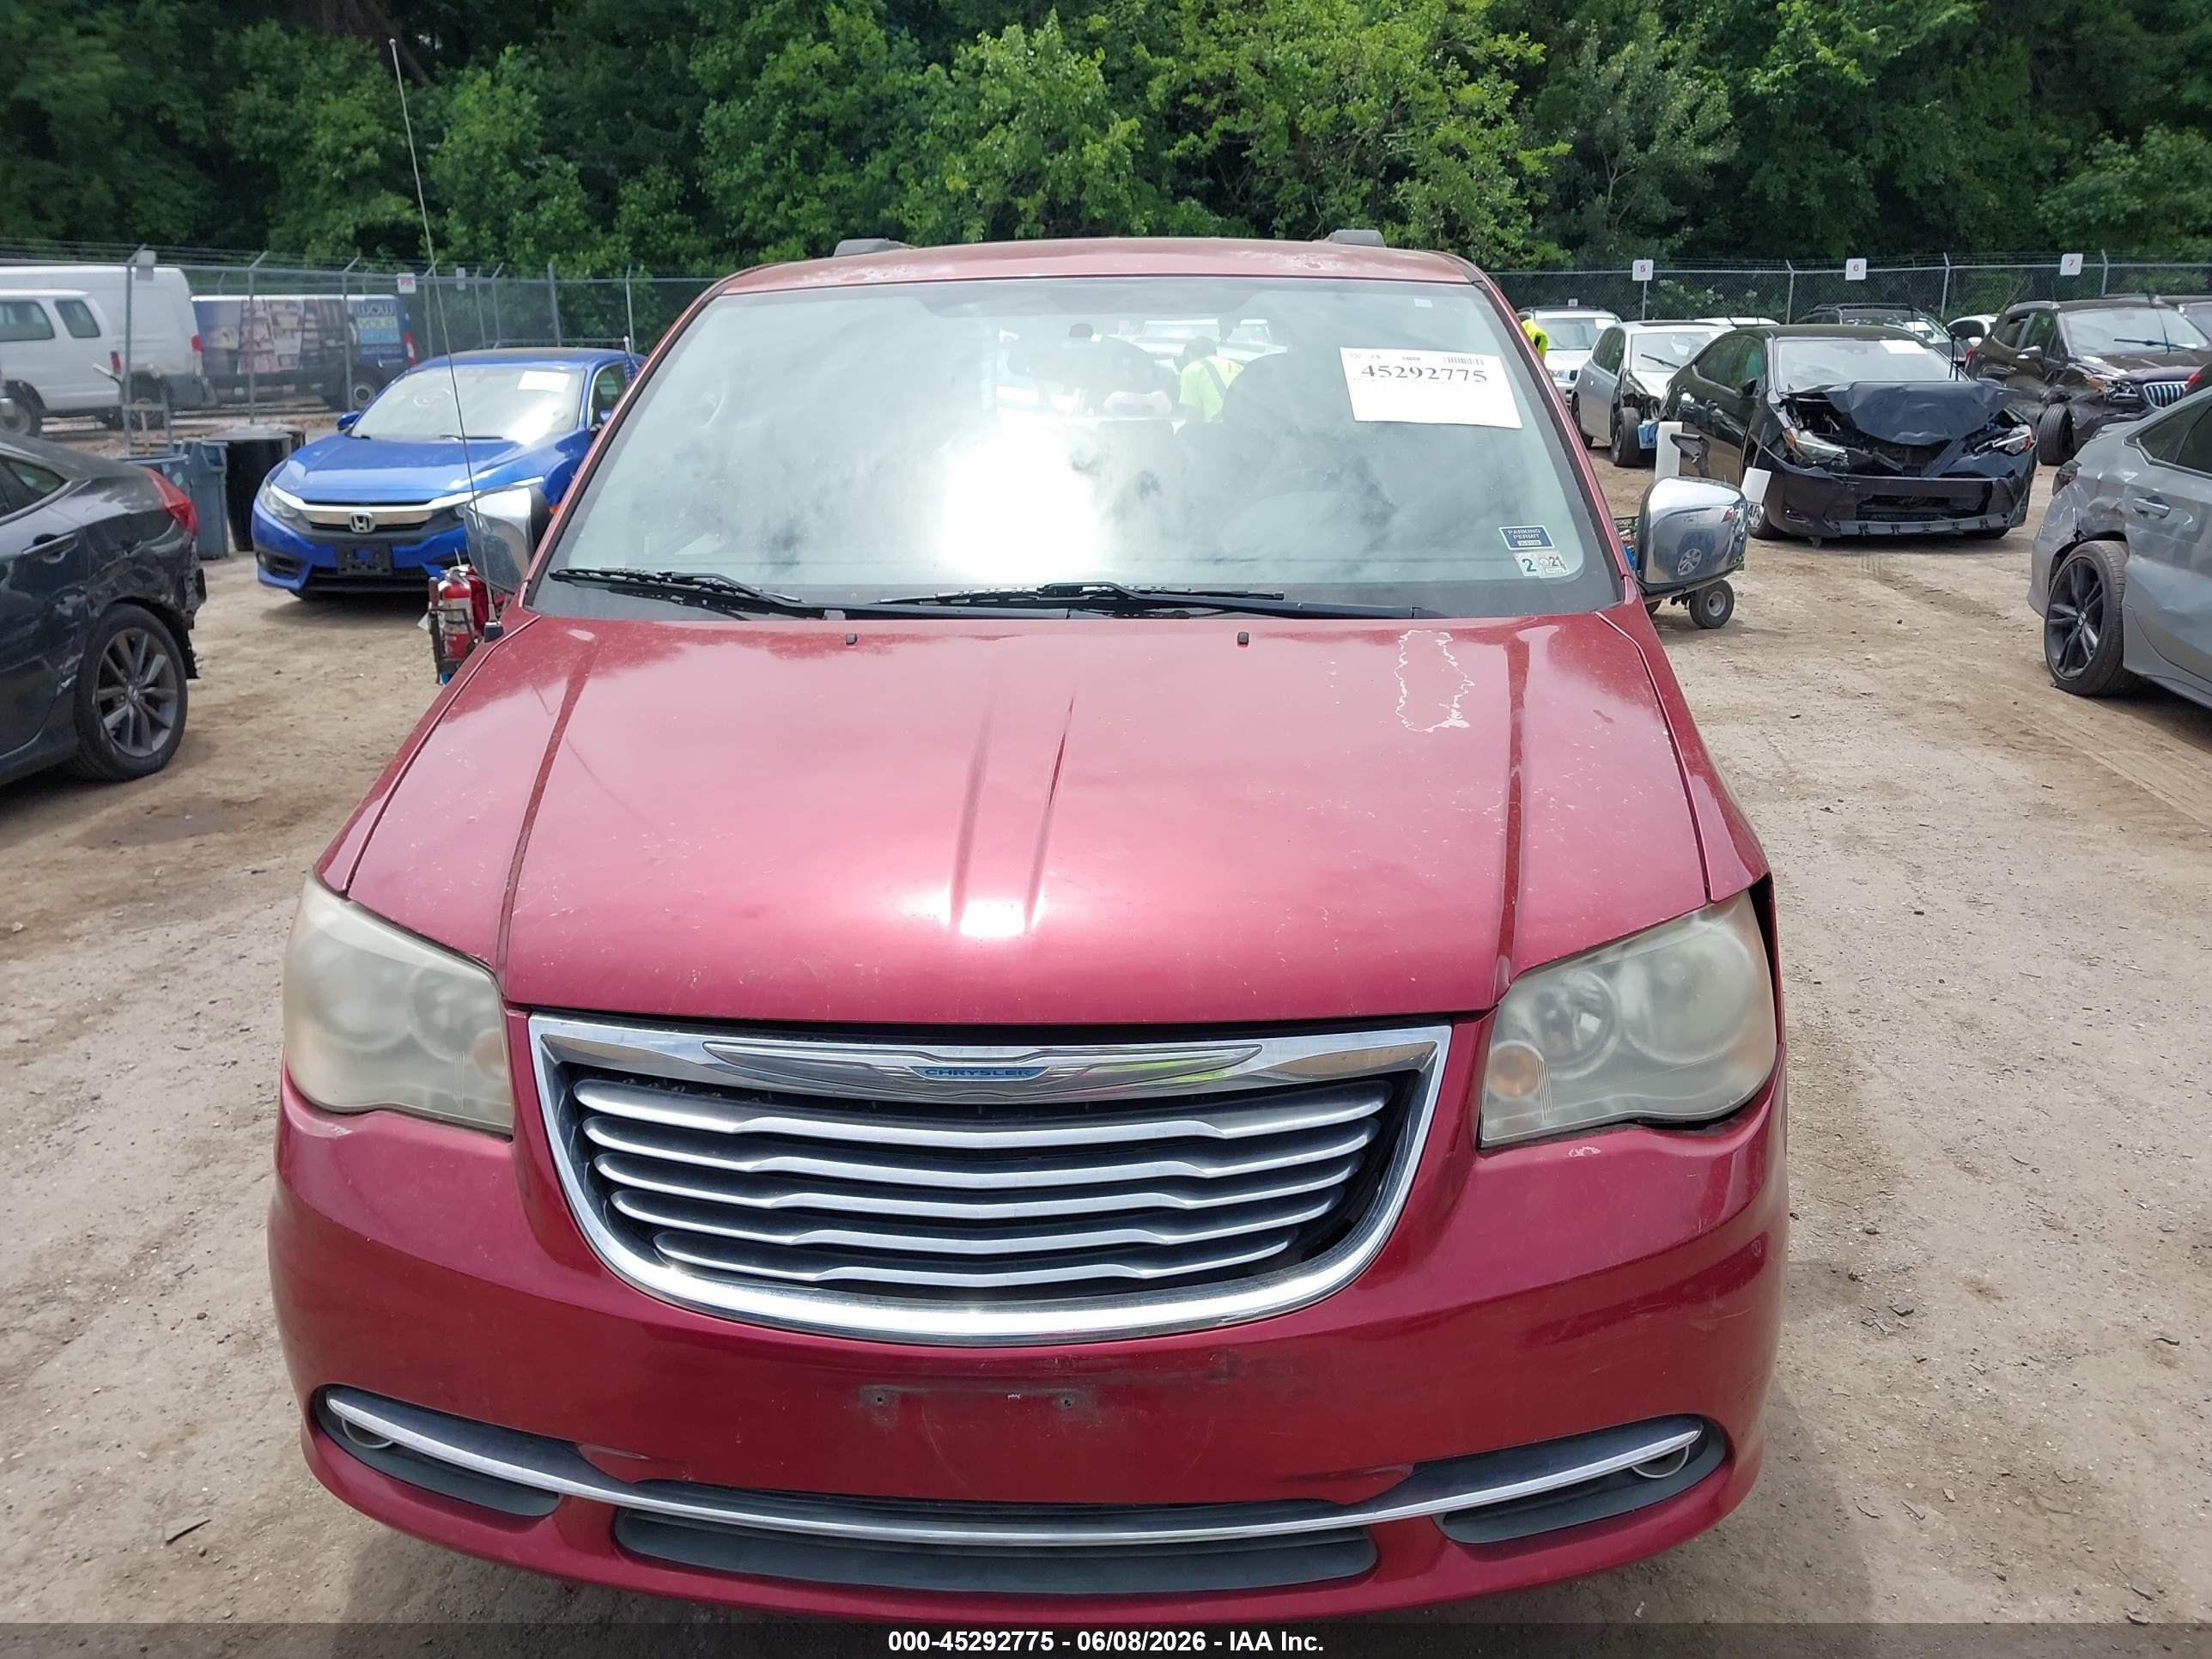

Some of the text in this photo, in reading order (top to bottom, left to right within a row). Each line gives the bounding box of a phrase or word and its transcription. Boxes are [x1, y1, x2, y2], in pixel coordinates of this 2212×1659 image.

[1361, 364, 1488, 383] 45292775
[1522, 558, 1537, 572] 2
[924, 1068, 1032, 1077] CHRYSLER
